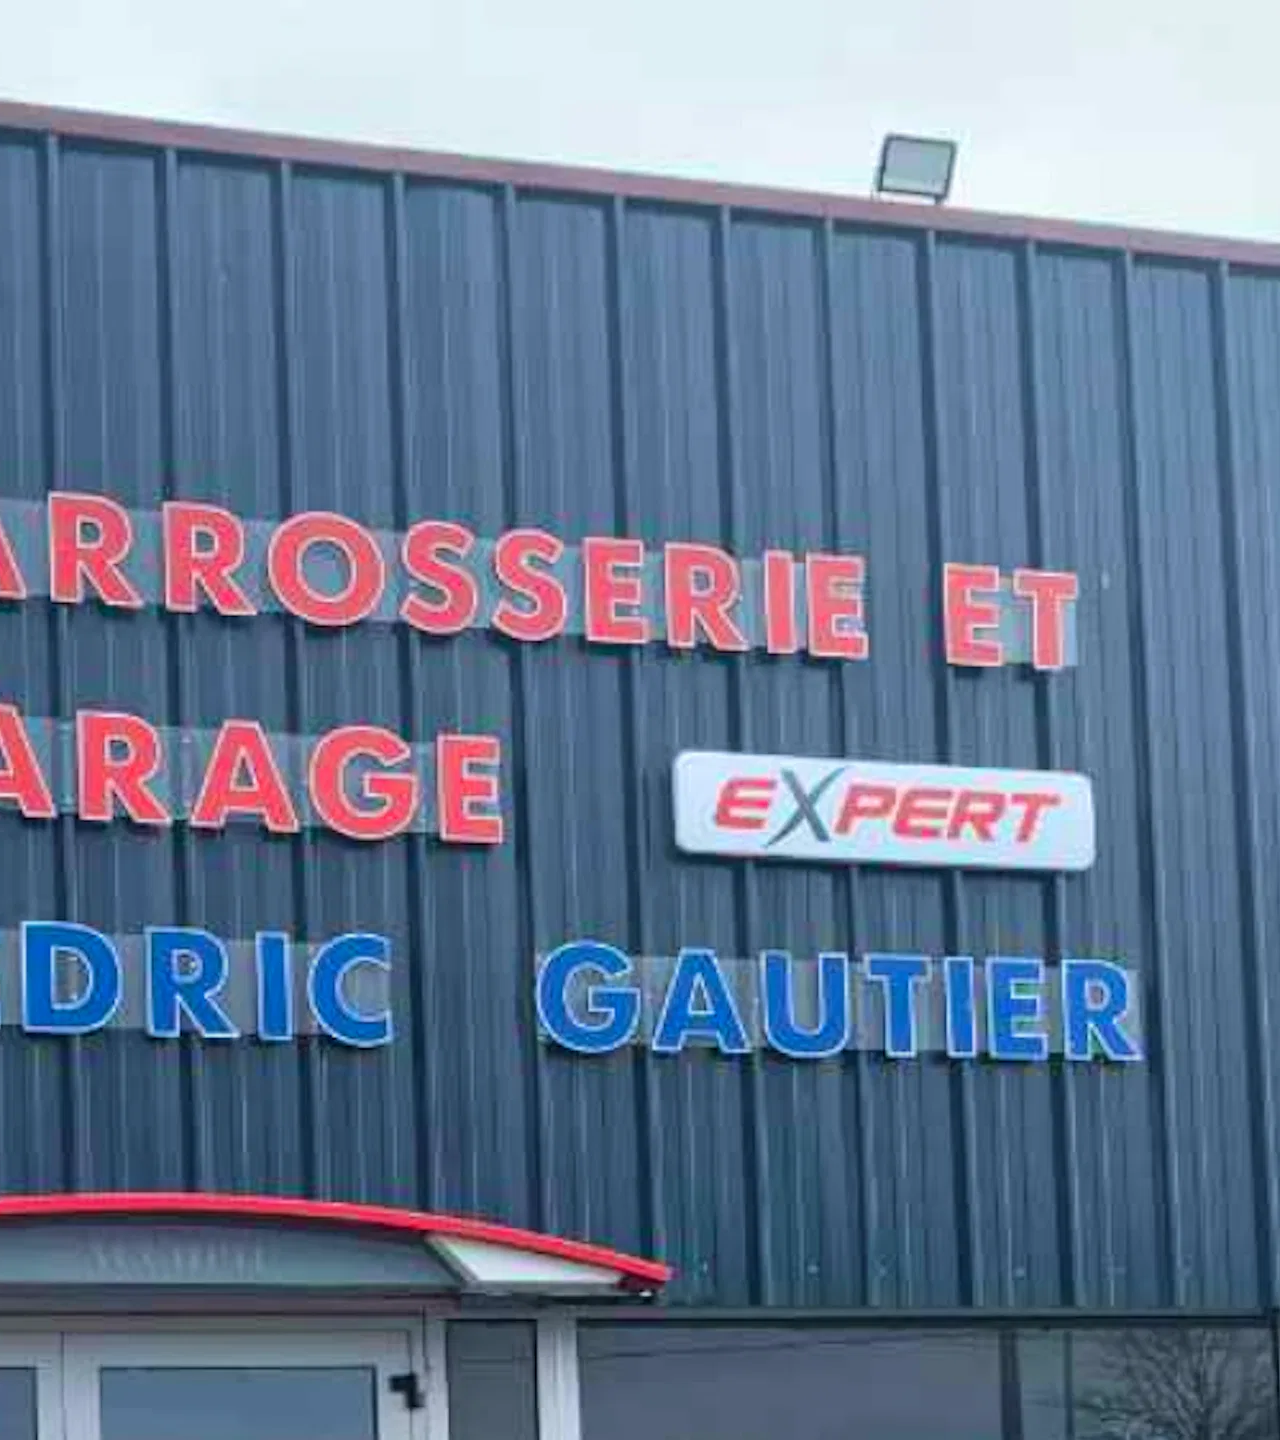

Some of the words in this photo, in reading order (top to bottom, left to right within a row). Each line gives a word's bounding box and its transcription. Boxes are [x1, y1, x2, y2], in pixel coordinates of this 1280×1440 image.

[943, 561, 1078, 671] ET
[713, 766, 1061, 848] EXPERT
[535, 939, 1144, 1061] GAUTIER
